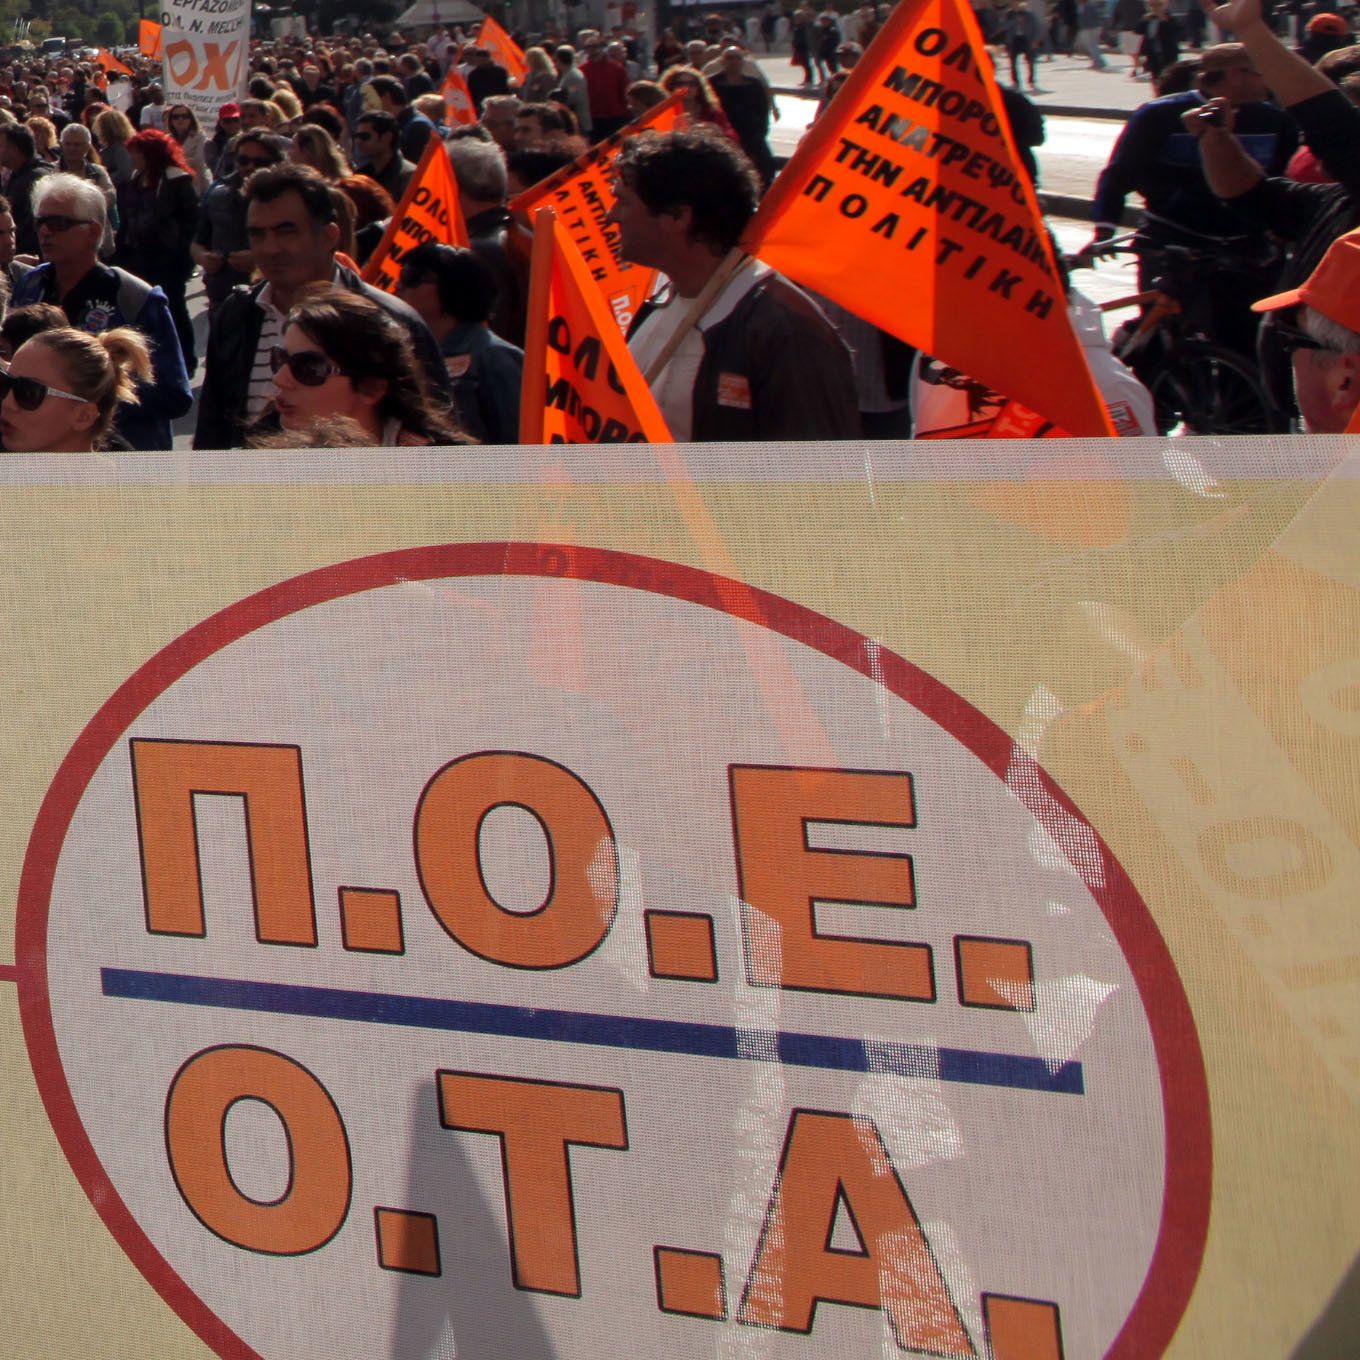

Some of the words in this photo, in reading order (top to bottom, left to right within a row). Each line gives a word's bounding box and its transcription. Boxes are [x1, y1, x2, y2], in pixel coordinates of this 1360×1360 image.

[835, 138, 904, 188] ΤΗΝ
[129, 737, 1037, 1013] Π.Ο.Ε.
[163, 1042, 1065, 1360] Ο.Τ.Α.
